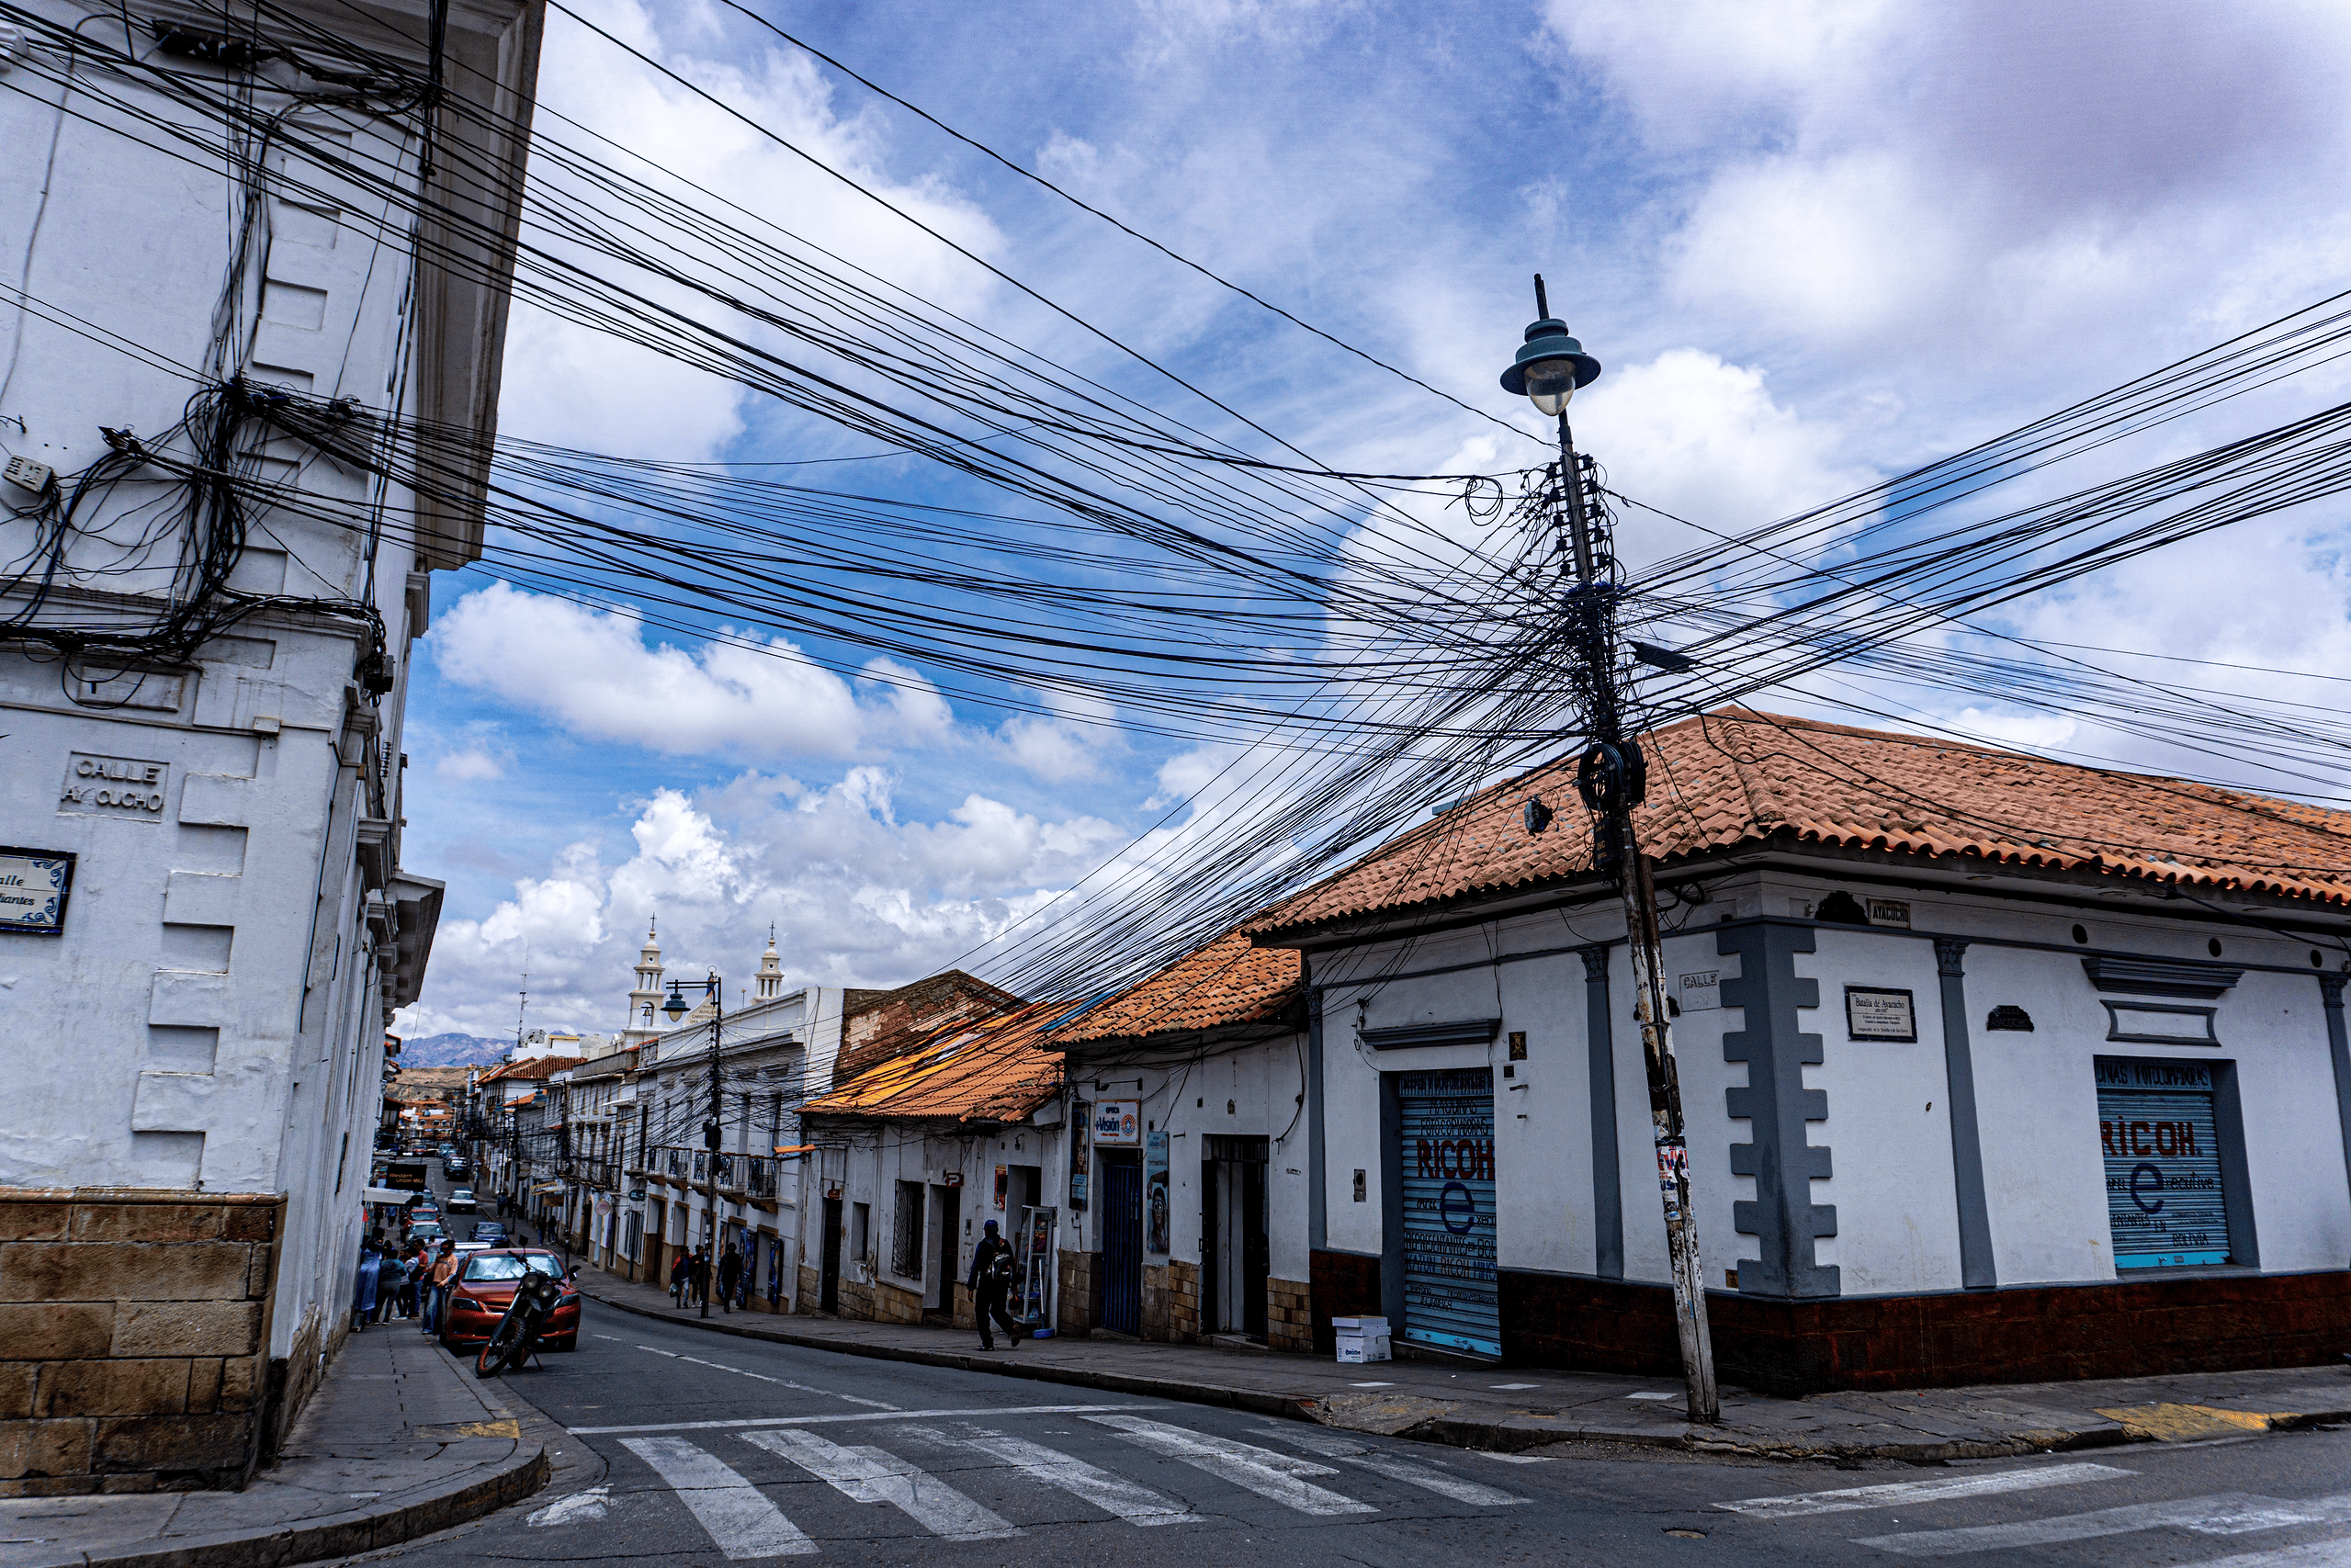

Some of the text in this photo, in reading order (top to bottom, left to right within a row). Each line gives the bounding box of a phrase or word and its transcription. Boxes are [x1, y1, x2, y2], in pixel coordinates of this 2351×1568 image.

[75, 760, 162, 784] CALLE
[1872, 905, 1909, 923] AYACUCHO
[1683, 974, 1718, 989] CALLE
[1882, 999, 1905, 1011] Ayacucho
[1430, 1100, 1476, 1114] MAQUINAS
[1420, 1117, 1488, 1136] FOTOCOPIADORAS
[1417, 1139, 1495, 1180] RICOH
[1406, 1232, 1467, 1256] REPRESENTANTES
[2173, 1233, 2209, 1247] BOLIVIA
[1406, 1253, 1436, 1274] KATUN
[1441, 1257, 1470, 1278] RICOH
